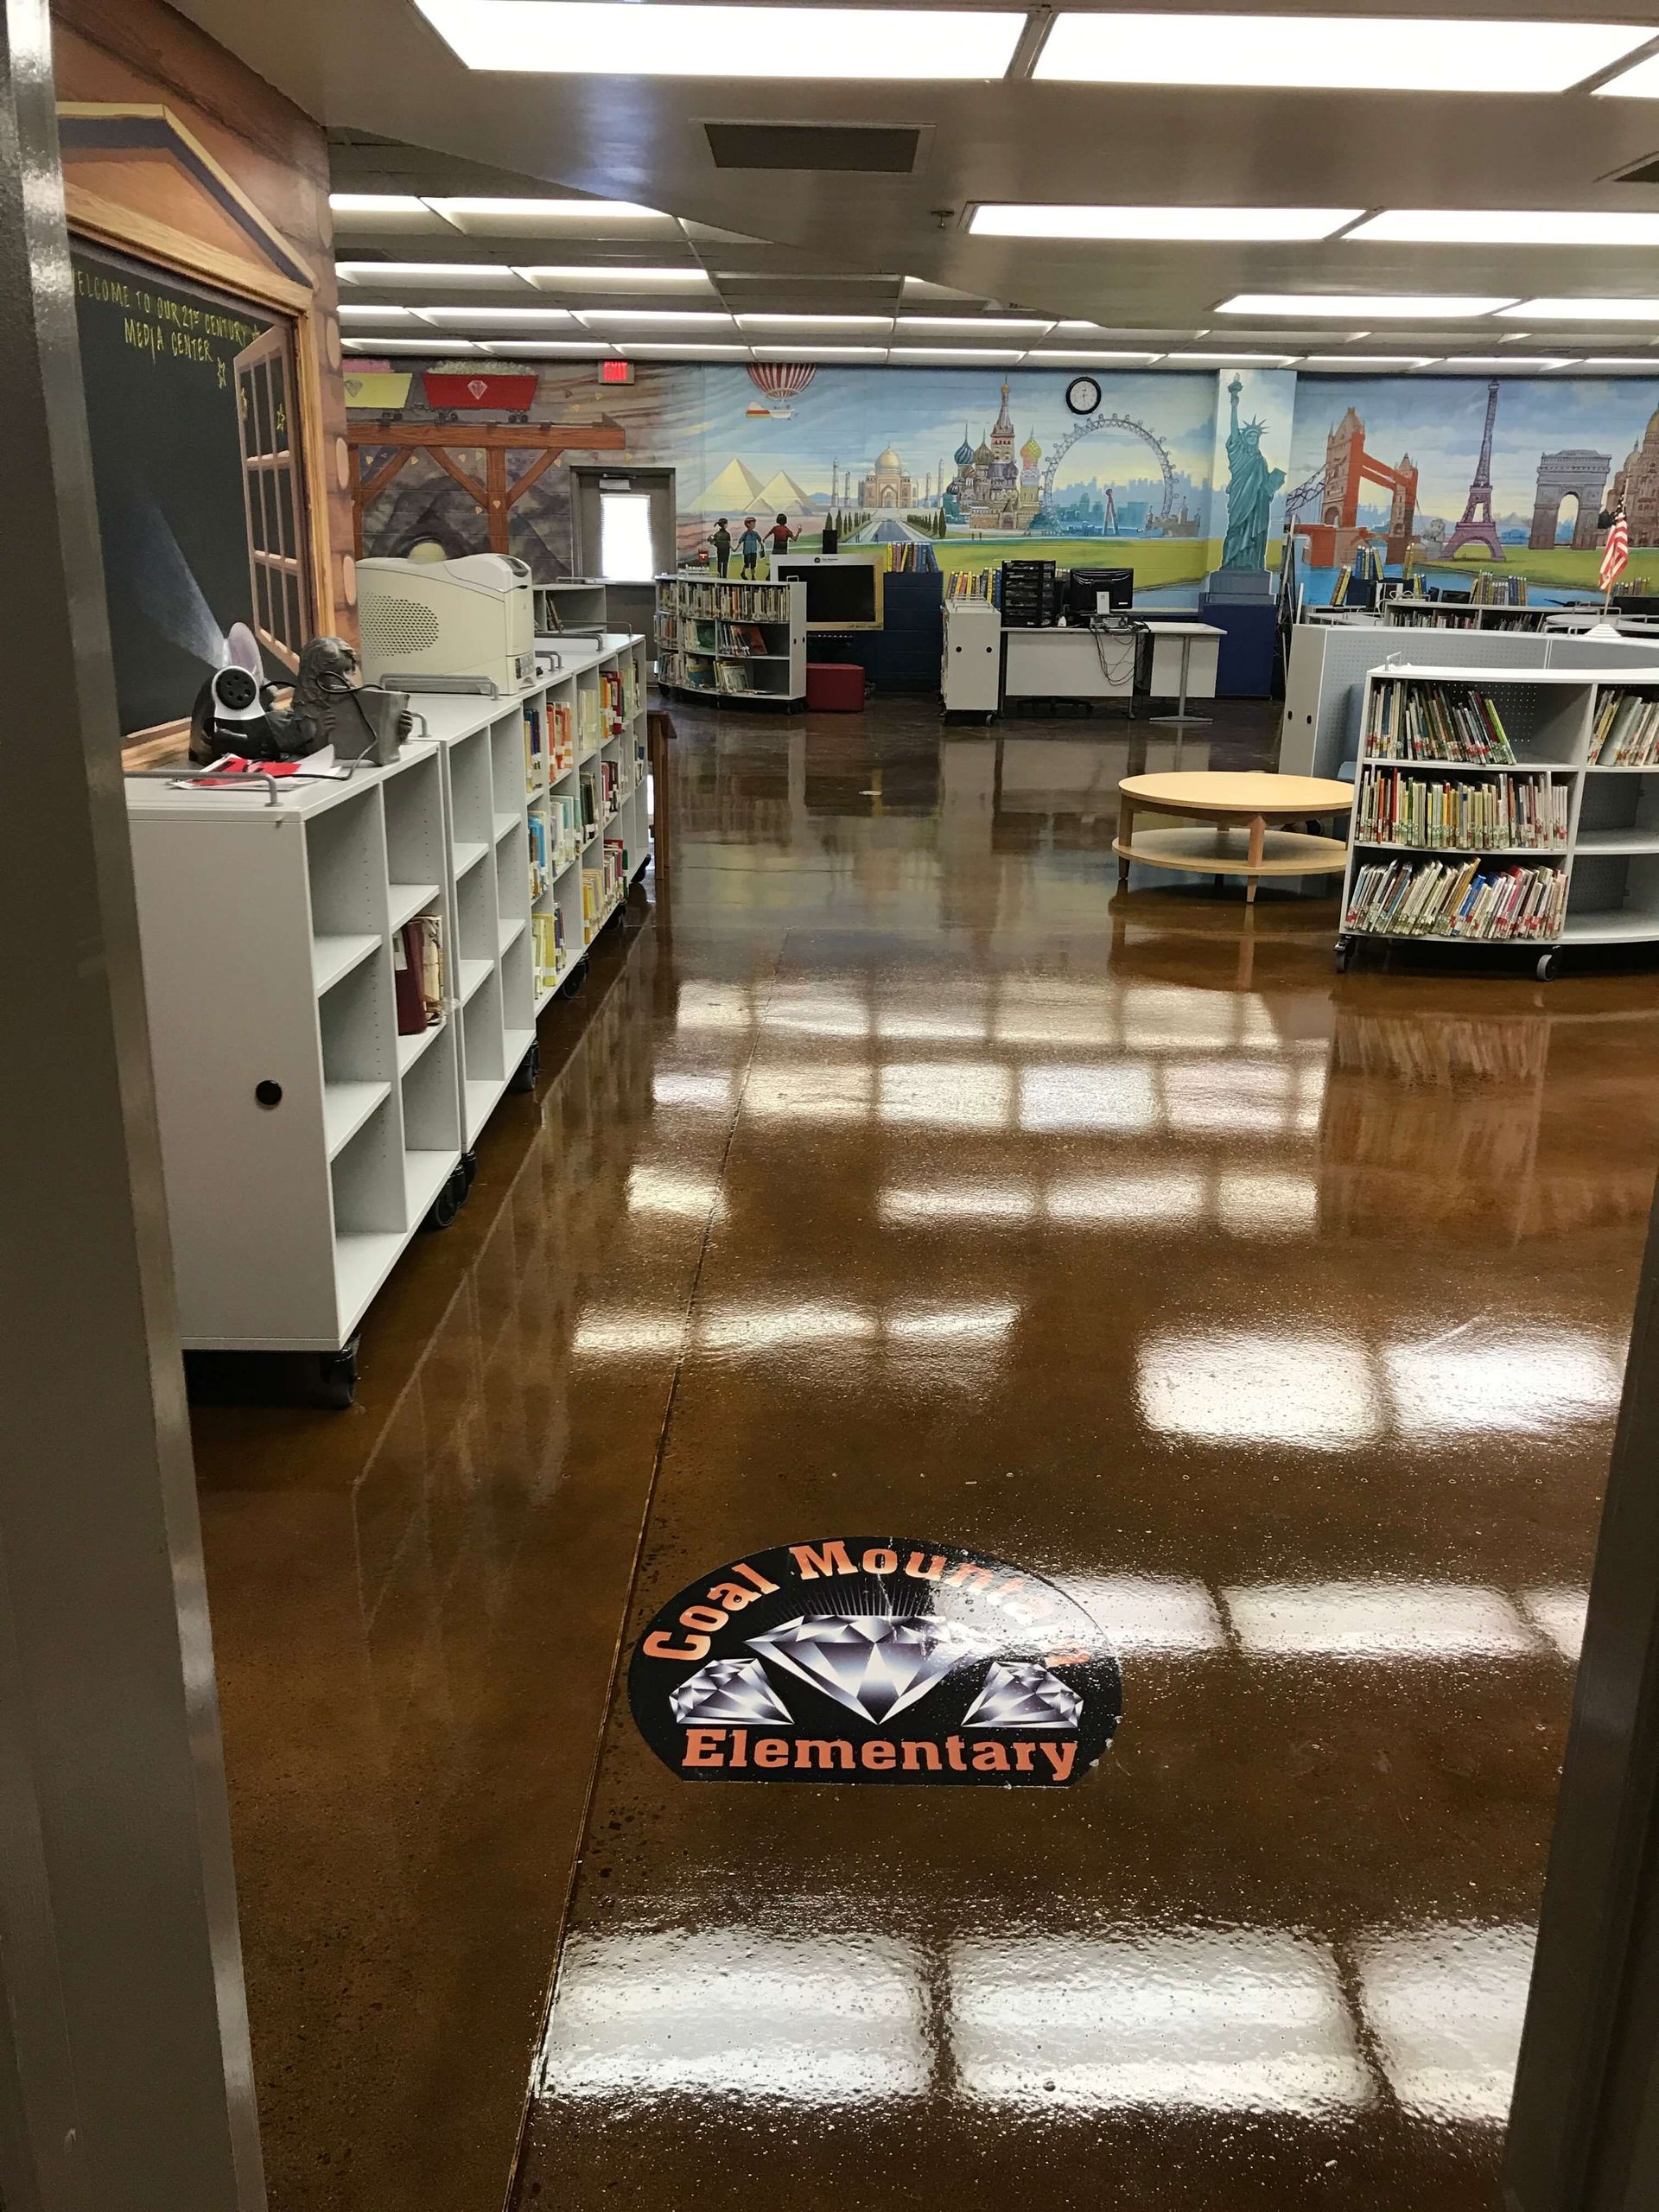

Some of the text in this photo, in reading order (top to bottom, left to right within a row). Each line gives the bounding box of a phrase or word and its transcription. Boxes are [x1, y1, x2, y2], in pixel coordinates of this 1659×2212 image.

[77, 270, 130, 308] ELCOME
[135, 290, 150, 313] TO
[157, 296, 181, 328] OUR
[204, 313, 248, 347] CENTURY
[124, 317, 214, 366] MEDIA CENTER
[643, 1563, 781, 1662] Coal
[682, 1728, 1078, 1782] Elementary
